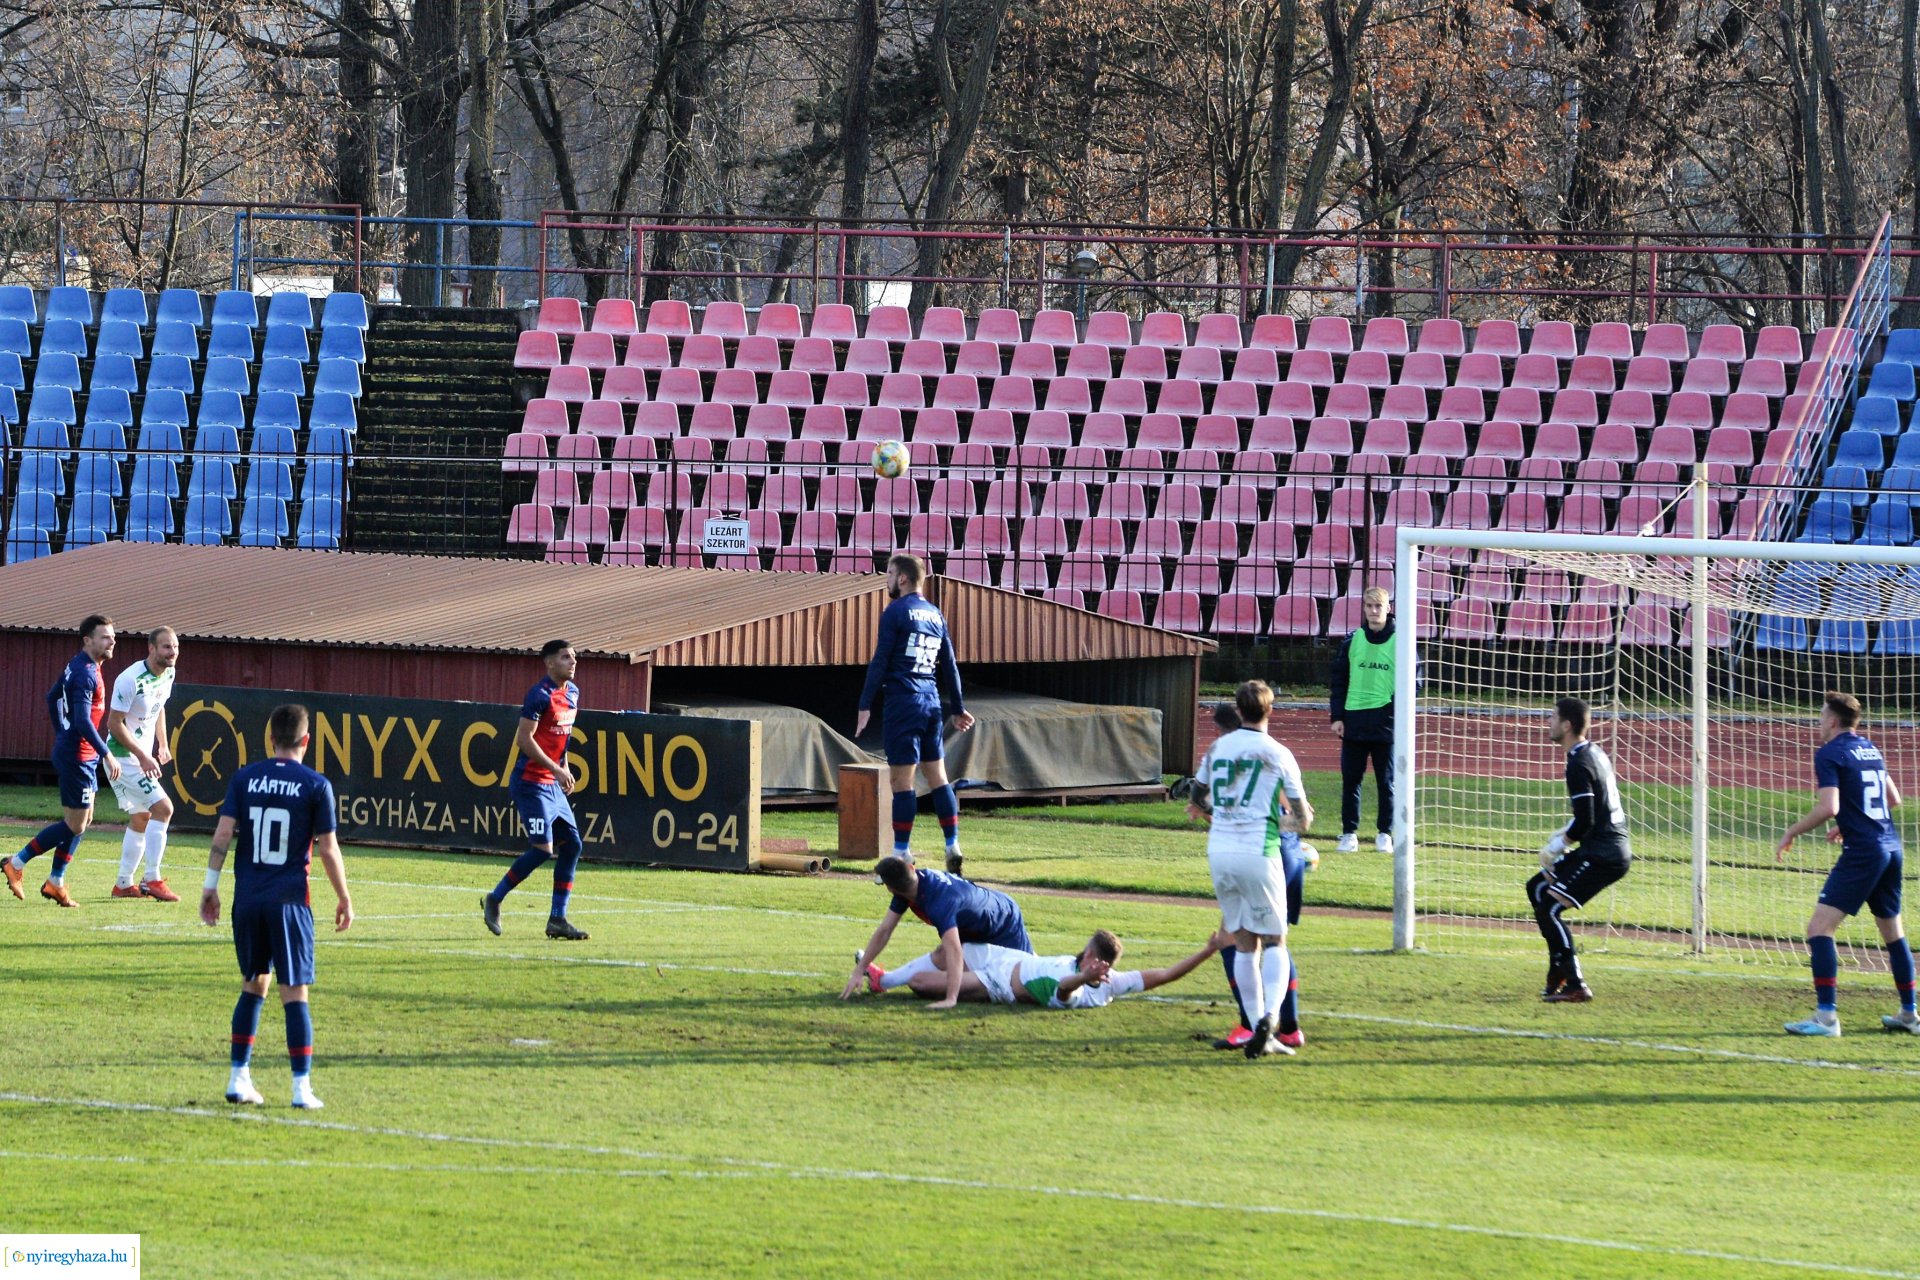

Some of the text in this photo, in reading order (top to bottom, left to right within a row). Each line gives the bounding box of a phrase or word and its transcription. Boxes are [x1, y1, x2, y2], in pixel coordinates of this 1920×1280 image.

[710, 525, 743, 537] LEZÁRT
[706, 538, 746, 548] SZEKTOR
[1368, 662, 1390, 671] JAKO
[264, 710, 442, 783] NYX
[137, 776, 157, 795] 5
[247, 775, 302, 798] KÁRTIK
[1212, 758, 1264, 807] 27
[1861, 769, 1891, 820] 21
[249, 806, 291, 866] 10
[528, 817, 545, 835] 30
